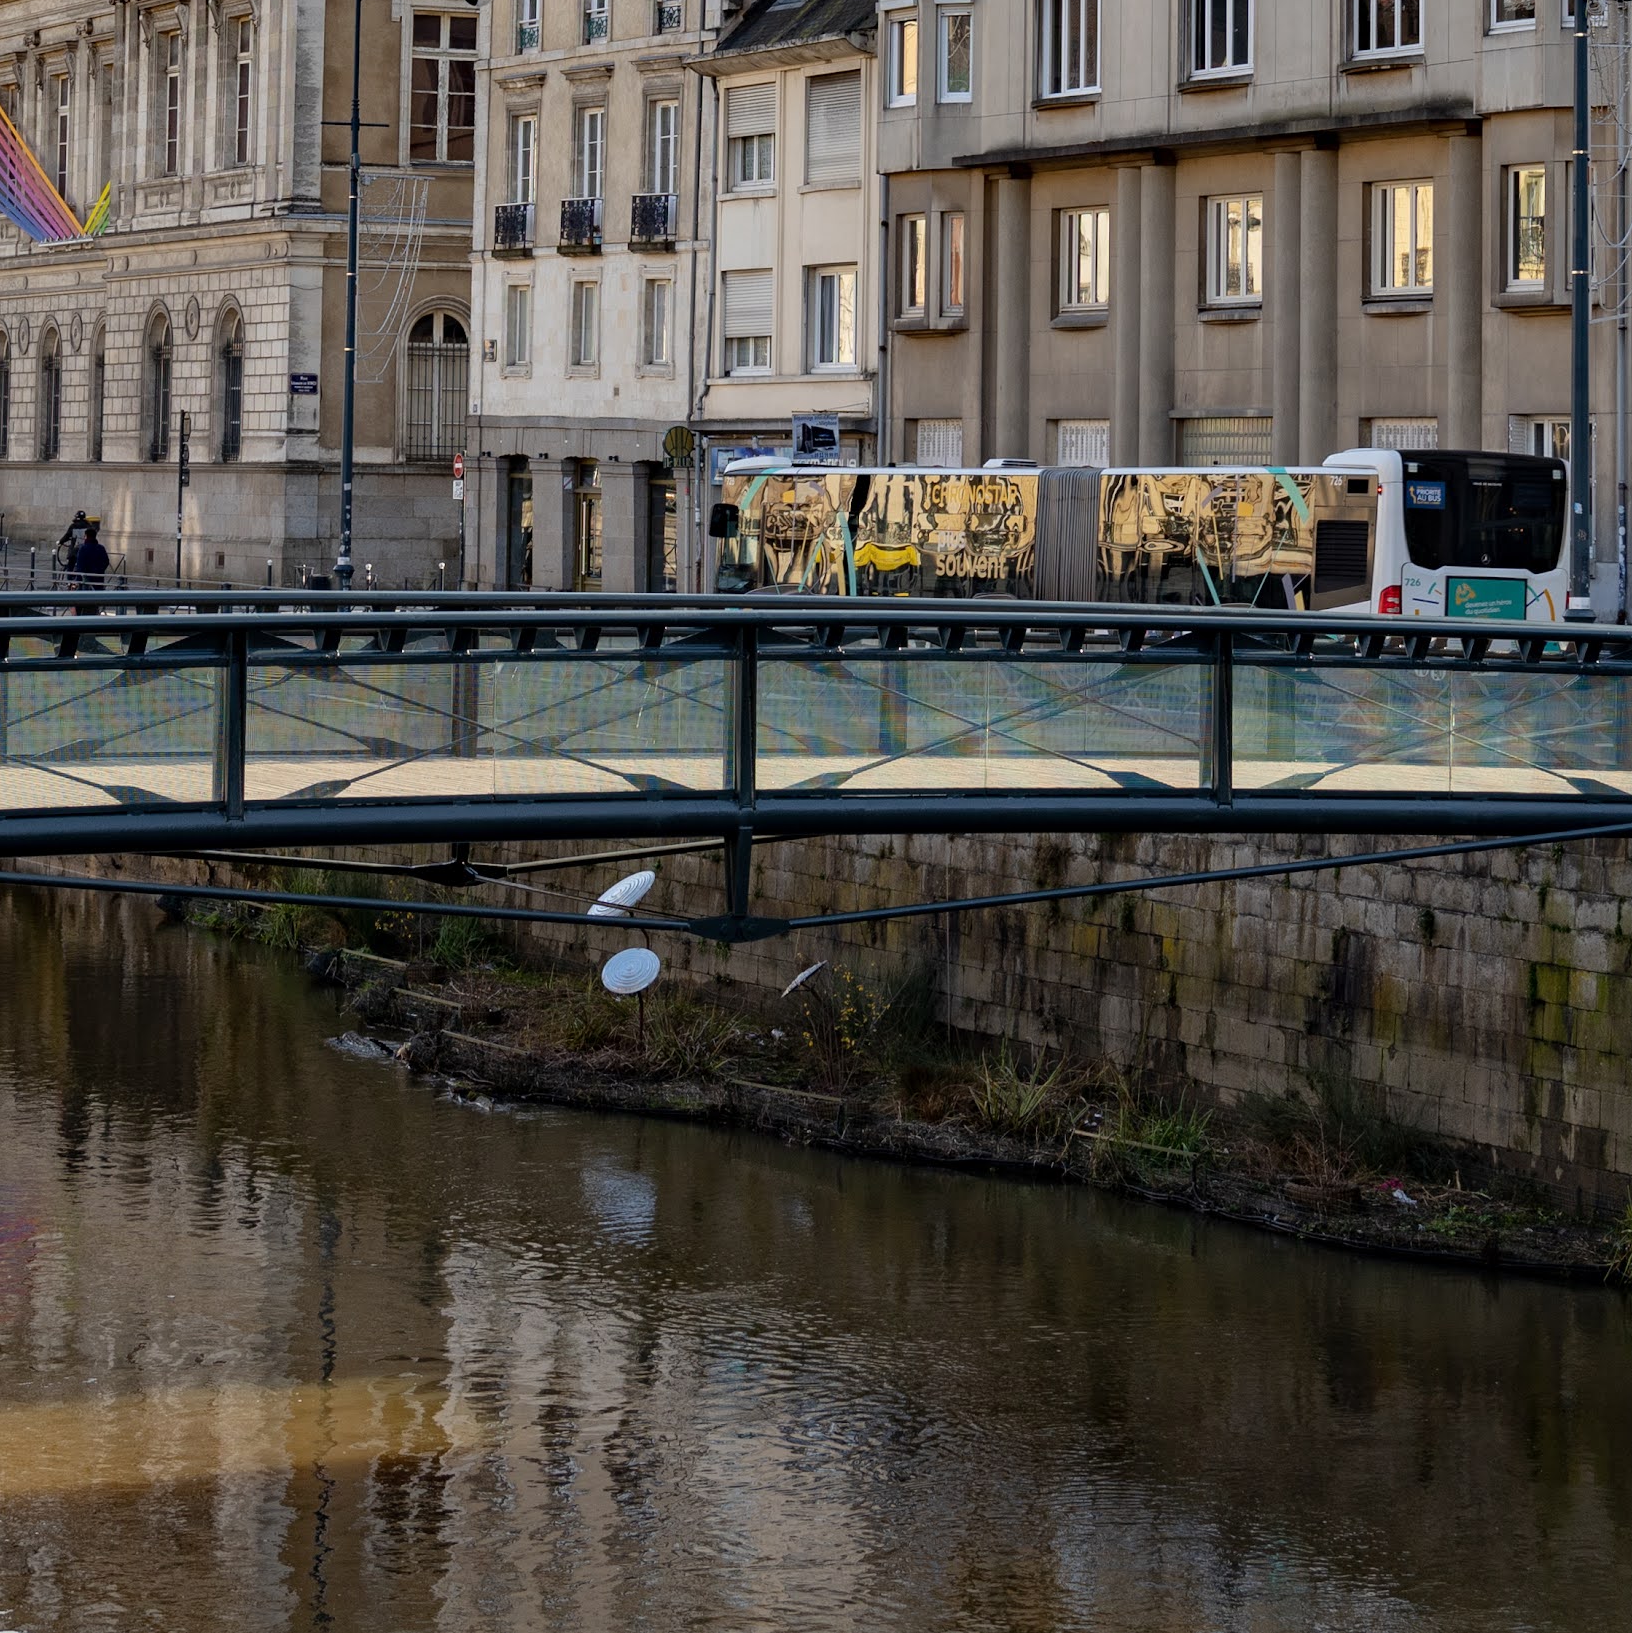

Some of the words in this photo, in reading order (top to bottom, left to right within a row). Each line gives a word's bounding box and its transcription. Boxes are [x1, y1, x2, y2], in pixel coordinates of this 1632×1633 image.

[1329, 475, 1343, 486] 726
[931, 484, 1018, 505] CHRONOSTAR
[1417, 494, 1427, 502] AU
[1428, 494, 1442, 502] BUS
[935, 553, 1007, 579] souvent
[1404, 578, 1422, 587] 726
